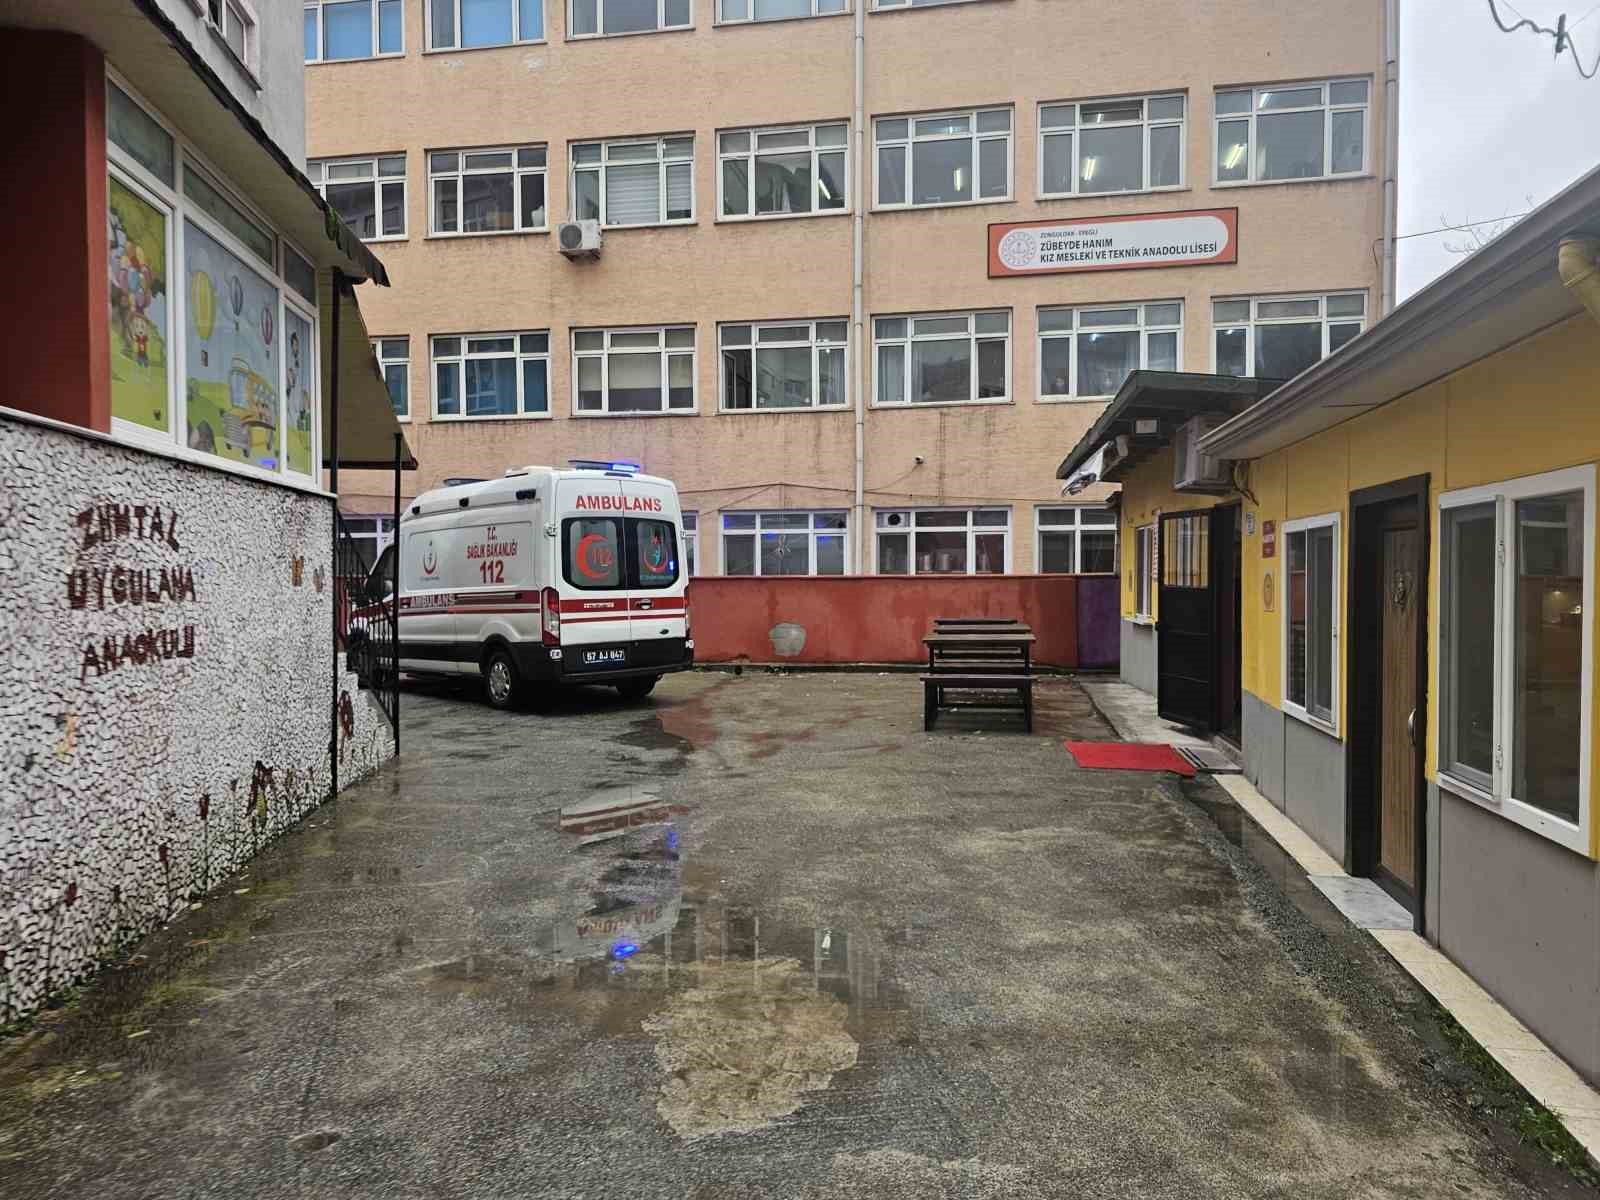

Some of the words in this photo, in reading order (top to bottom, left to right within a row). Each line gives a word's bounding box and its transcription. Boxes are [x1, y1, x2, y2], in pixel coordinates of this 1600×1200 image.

[1040, 239, 1080, 252] ZÜBEYDE
[1082, 238, 1113, 249] HANIM
[1040, 253, 1054, 263] KIZ
[1056, 249, 1094, 262] MESLEKİ
[1096, 251, 1107, 260] VE
[1107, 247, 1141, 259] TEKNİK
[1143, 244, 1187, 257] ANADOLU
[1189, 241, 1217, 254] LİSESİ
[575, 495, 662, 512] AMBULANS
[487, 526, 498, 542] T.C.
[467, 541, 486, 559] SAĞLIK
[486, 539, 518, 558] BAKANLIĞI
[480, 560, 504, 584] 112
